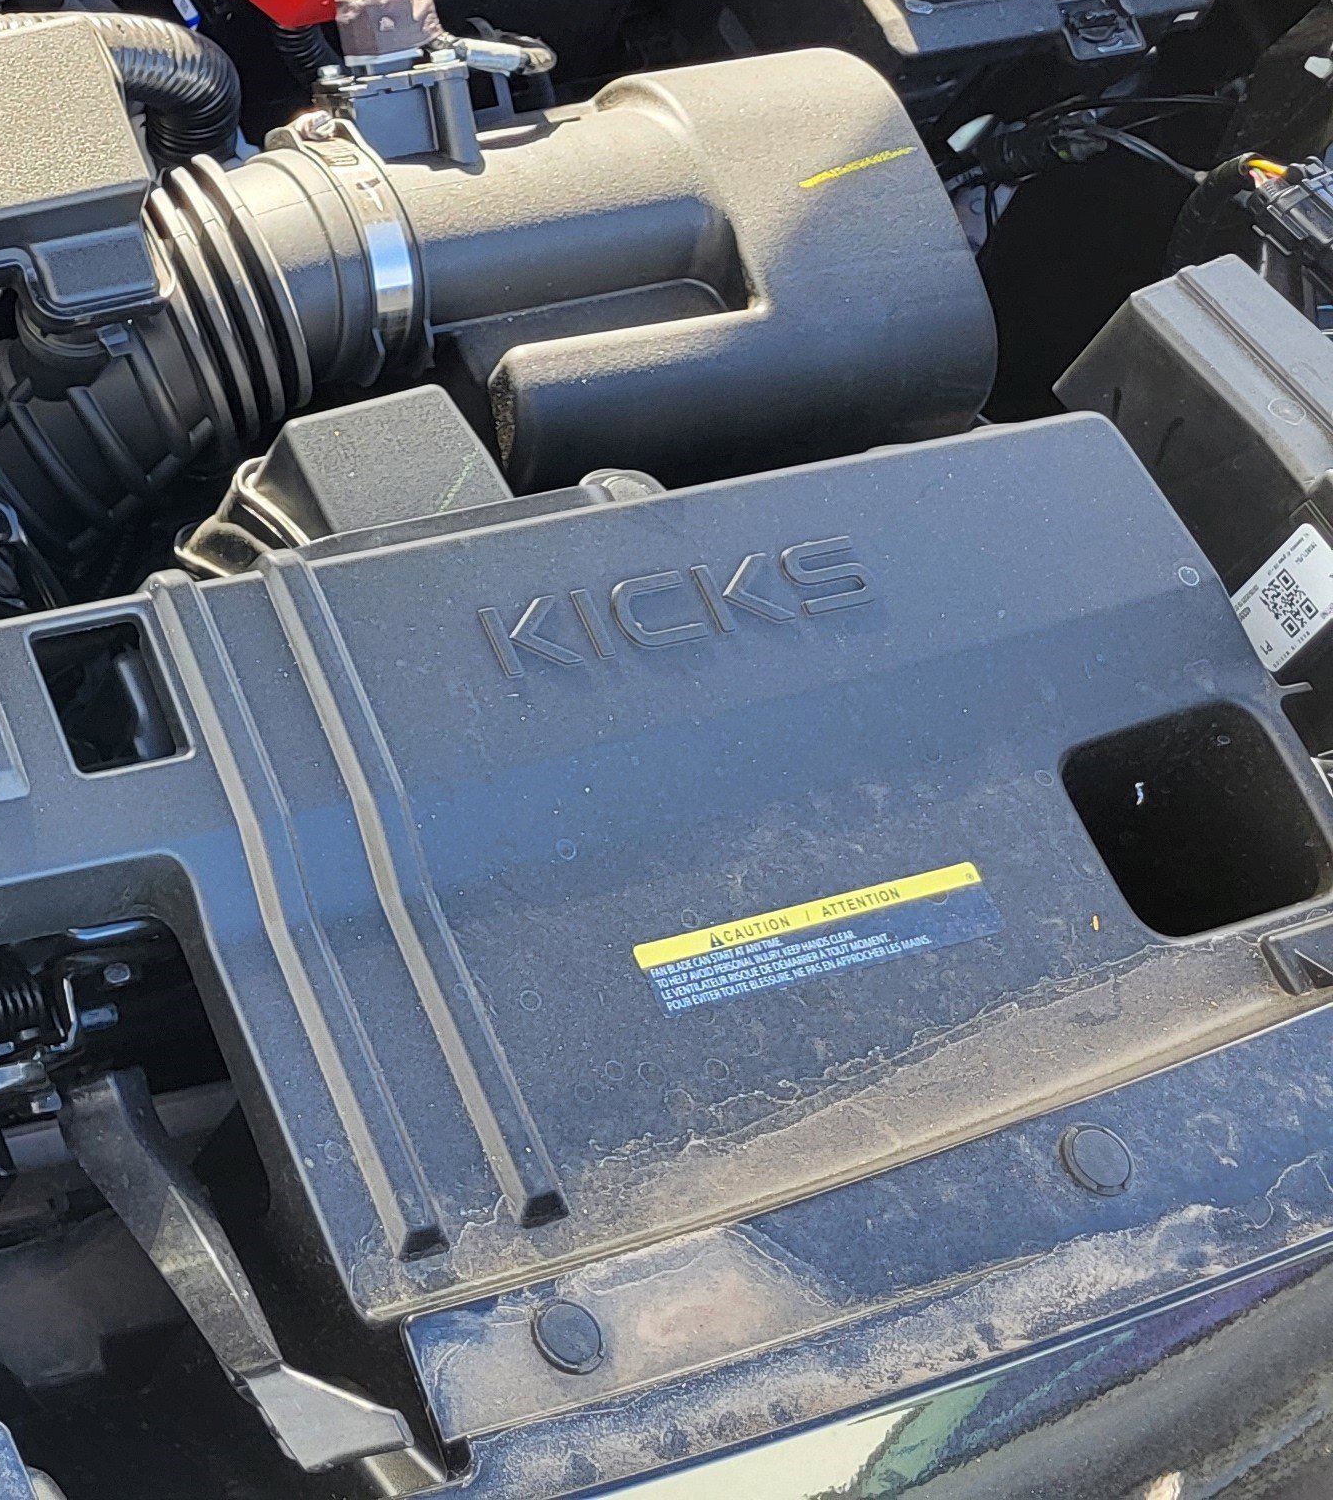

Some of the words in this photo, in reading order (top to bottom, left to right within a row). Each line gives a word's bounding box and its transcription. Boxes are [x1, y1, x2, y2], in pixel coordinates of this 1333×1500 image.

[478, 536, 876, 678] KICKS
[1259, 640, 1273, 656] P1
[723, 916, 791, 942] CAUTION
[822, 888, 900, 917] ATTENTION
[649, 965, 669, 978] FAN
[665, 958, 694, 974] BLADE
[690, 953, 712, 968] CAN
[708, 947, 735, 963] START
[732, 945, 746, 957] AT
[654, 977, 670, 990] TO
[666, 972, 690, 987] HELP
[687, 965, 715, 981] AVOID
[711, 954, 756, 975] PERSONAL
[780, 942, 802, 957] KEEP
[799, 935, 830, 952] HANDS
[659, 988, 676, 1001] LE
[671, 973, 729, 998] VENTILATEUR
[726, 965, 761, 983] RISQUE
[758, 961, 774, 975] DE
[771, 949, 819, 972] DÉMARRER
[817, 947, 828, 959] À
[824, 941, 850, 958] TOUT
[664, 995, 693, 1012] POUR
[690, 987, 722, 1005] ÉVITER
[718, 980, 751, 998] TOUTE
[791, 965, 807, 979] NE
[804, 961, 823, 975] PAS
[821, 957, 837, 971] EN
[834, 944, 887, 968] APPROCHER
[884, 940, 902, 954] LES
